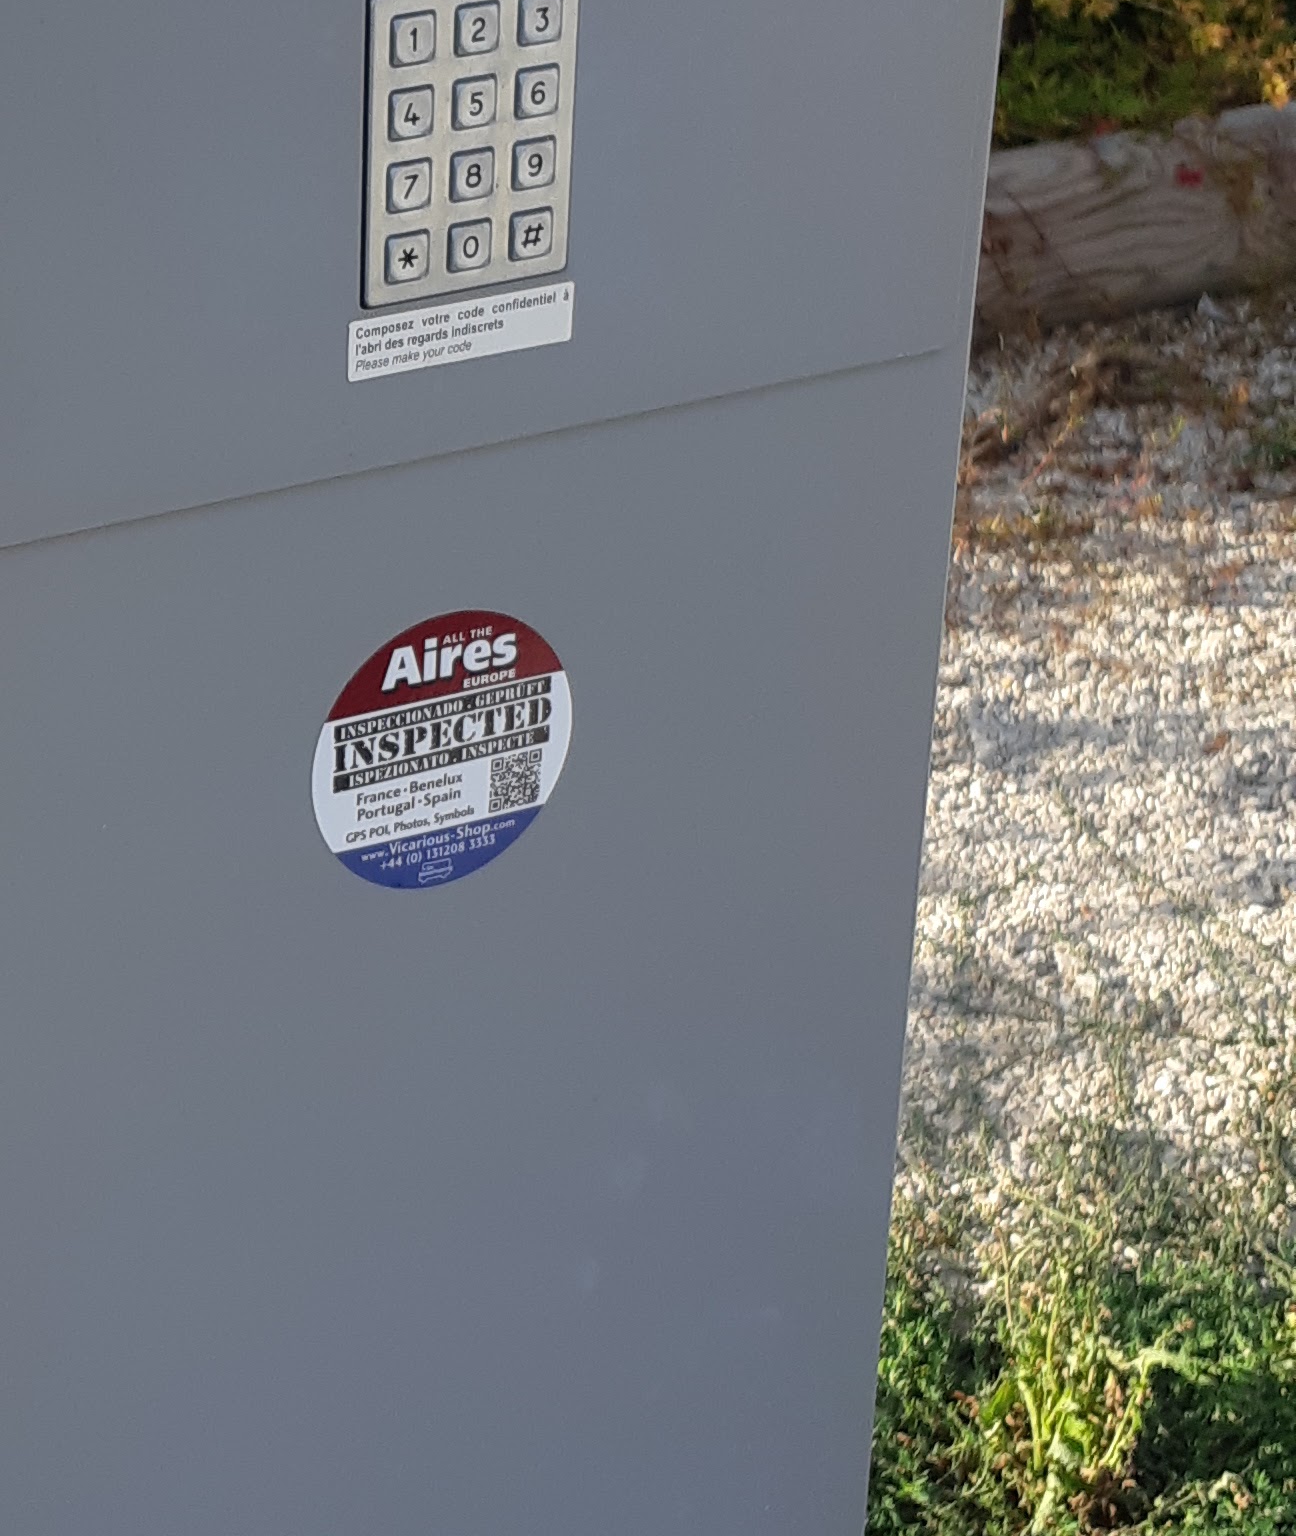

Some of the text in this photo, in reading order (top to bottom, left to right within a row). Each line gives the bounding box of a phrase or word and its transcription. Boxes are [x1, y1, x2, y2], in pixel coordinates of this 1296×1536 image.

[409, 6, 549, 52] 1 2 3
[404, 81, 546, 126] 4 5 6
[404, 153, 543, 200] 7 8 9
[463, 235, 479, 259] 0
[355, 319, 414, 340] Composez
[422, 312, 450, 328] votre
[457, 306, 485, 321] code
[492, 290, 556, 314] confidentiel
[355, 319, 504, 356] l'abri des regards indiscrets
[355, 340, 472, 373] Please make your code
[442, 626, 493, 645] ALL THE
[381, 632, 517, 692] Aires
[463, 668, 516, 688] EUROPE
[333, 697, 552, 773] INSPECTED
[340, 699, 463, 740] INSPECCIONADO
[349, 752, 449, 787] ISPEZIONATO
[356, 773, 462, 806] France Benelux
[357, 789, 461, 821] Portugal Spain
[346, 830, 366, 843] GPS
[433, 806, 475, 825] Symbols
[380, 855, 402, 870] +44
[405, 850, 422, 865] (0)
[426, 841, 465, 860] 131208
